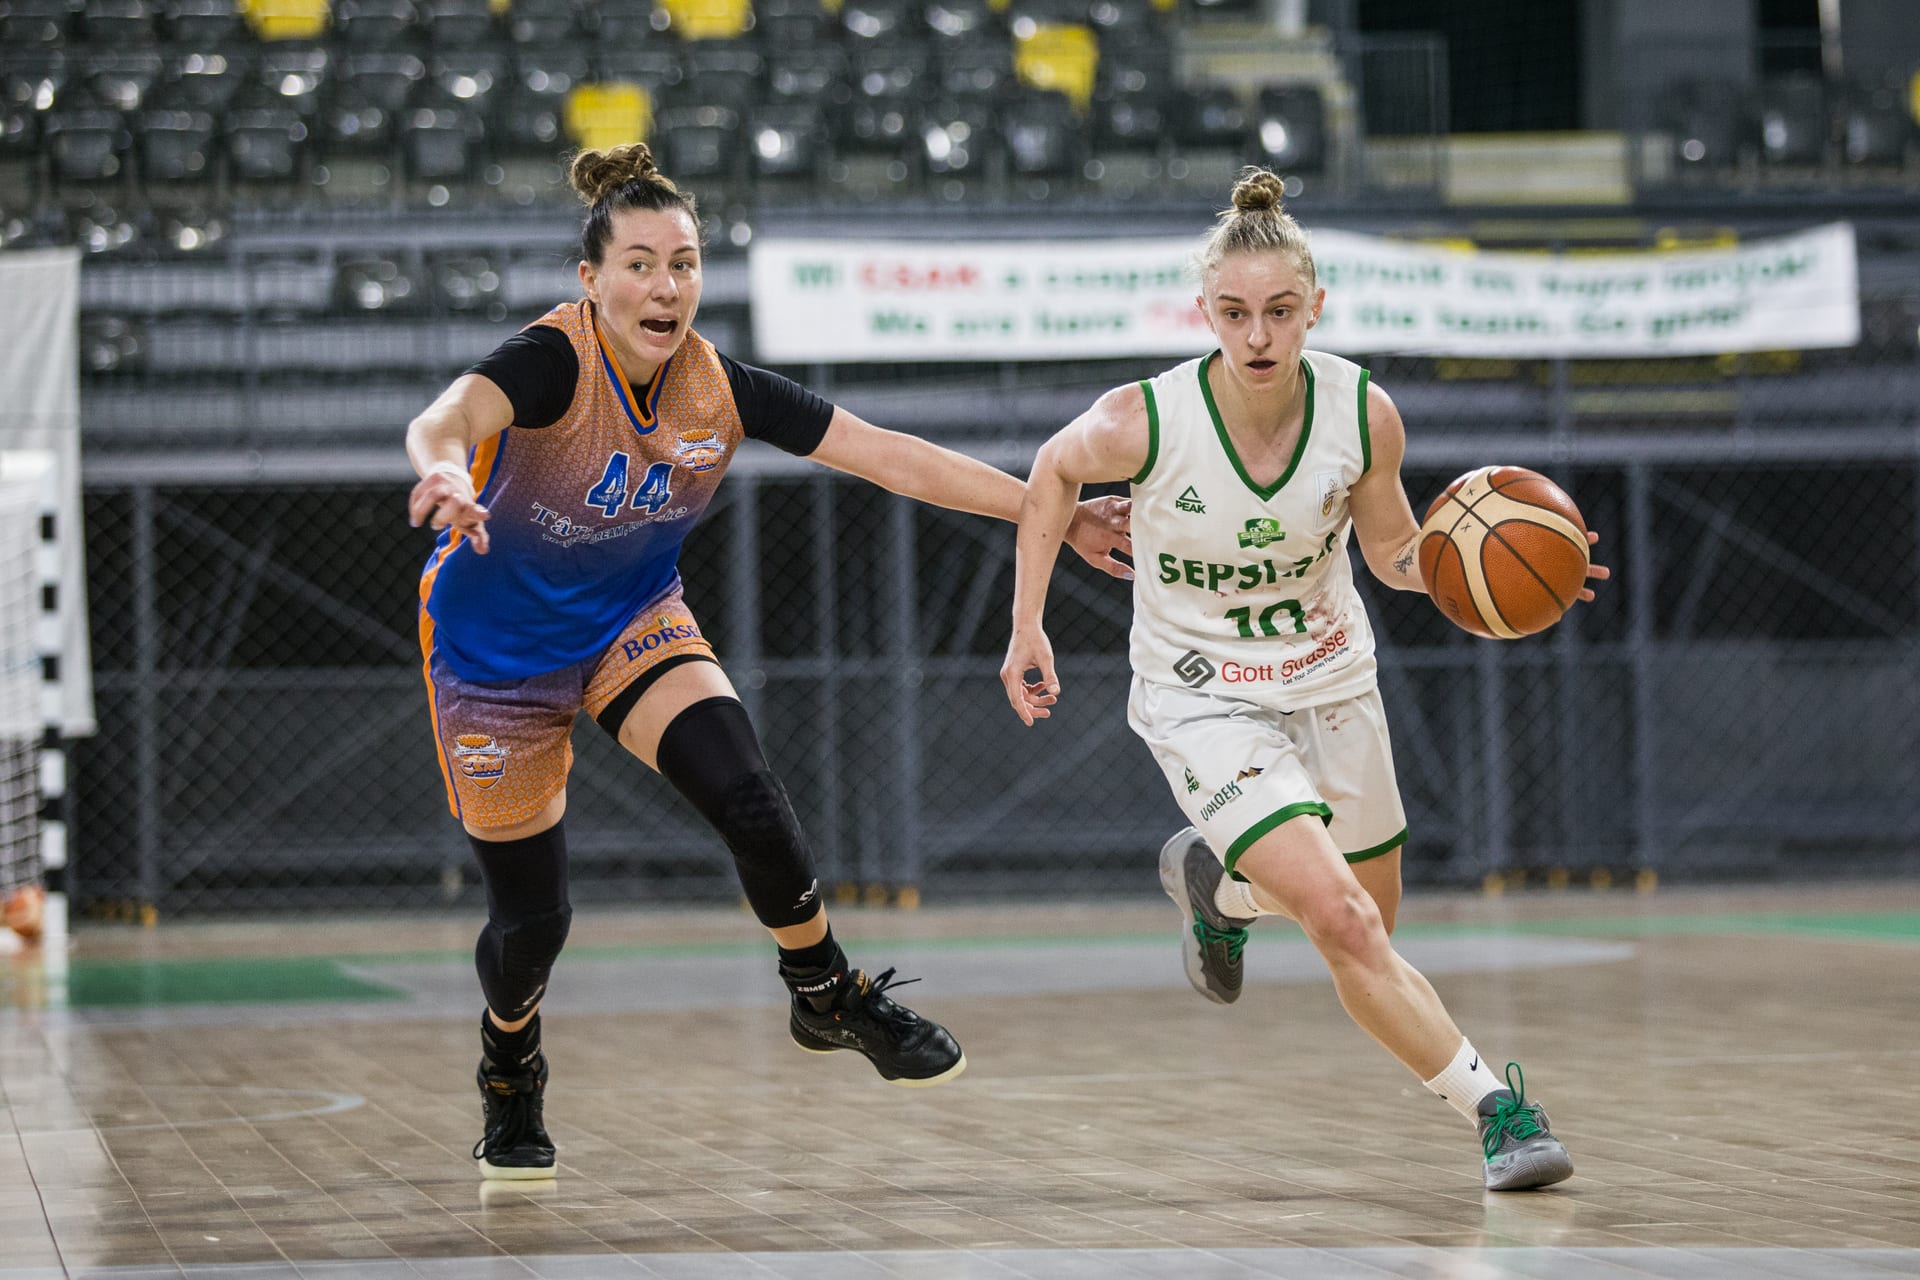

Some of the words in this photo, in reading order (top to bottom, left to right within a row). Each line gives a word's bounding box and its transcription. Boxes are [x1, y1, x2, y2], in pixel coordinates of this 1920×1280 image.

[585, 450, 676, 518] 44
[1175, 500, 1207, 514] PEAK
[1224, 599, 1308, 638] 10
[1221, 661, 1273, 683] Gott
[1280, 629, 1347, 679] Strasse
